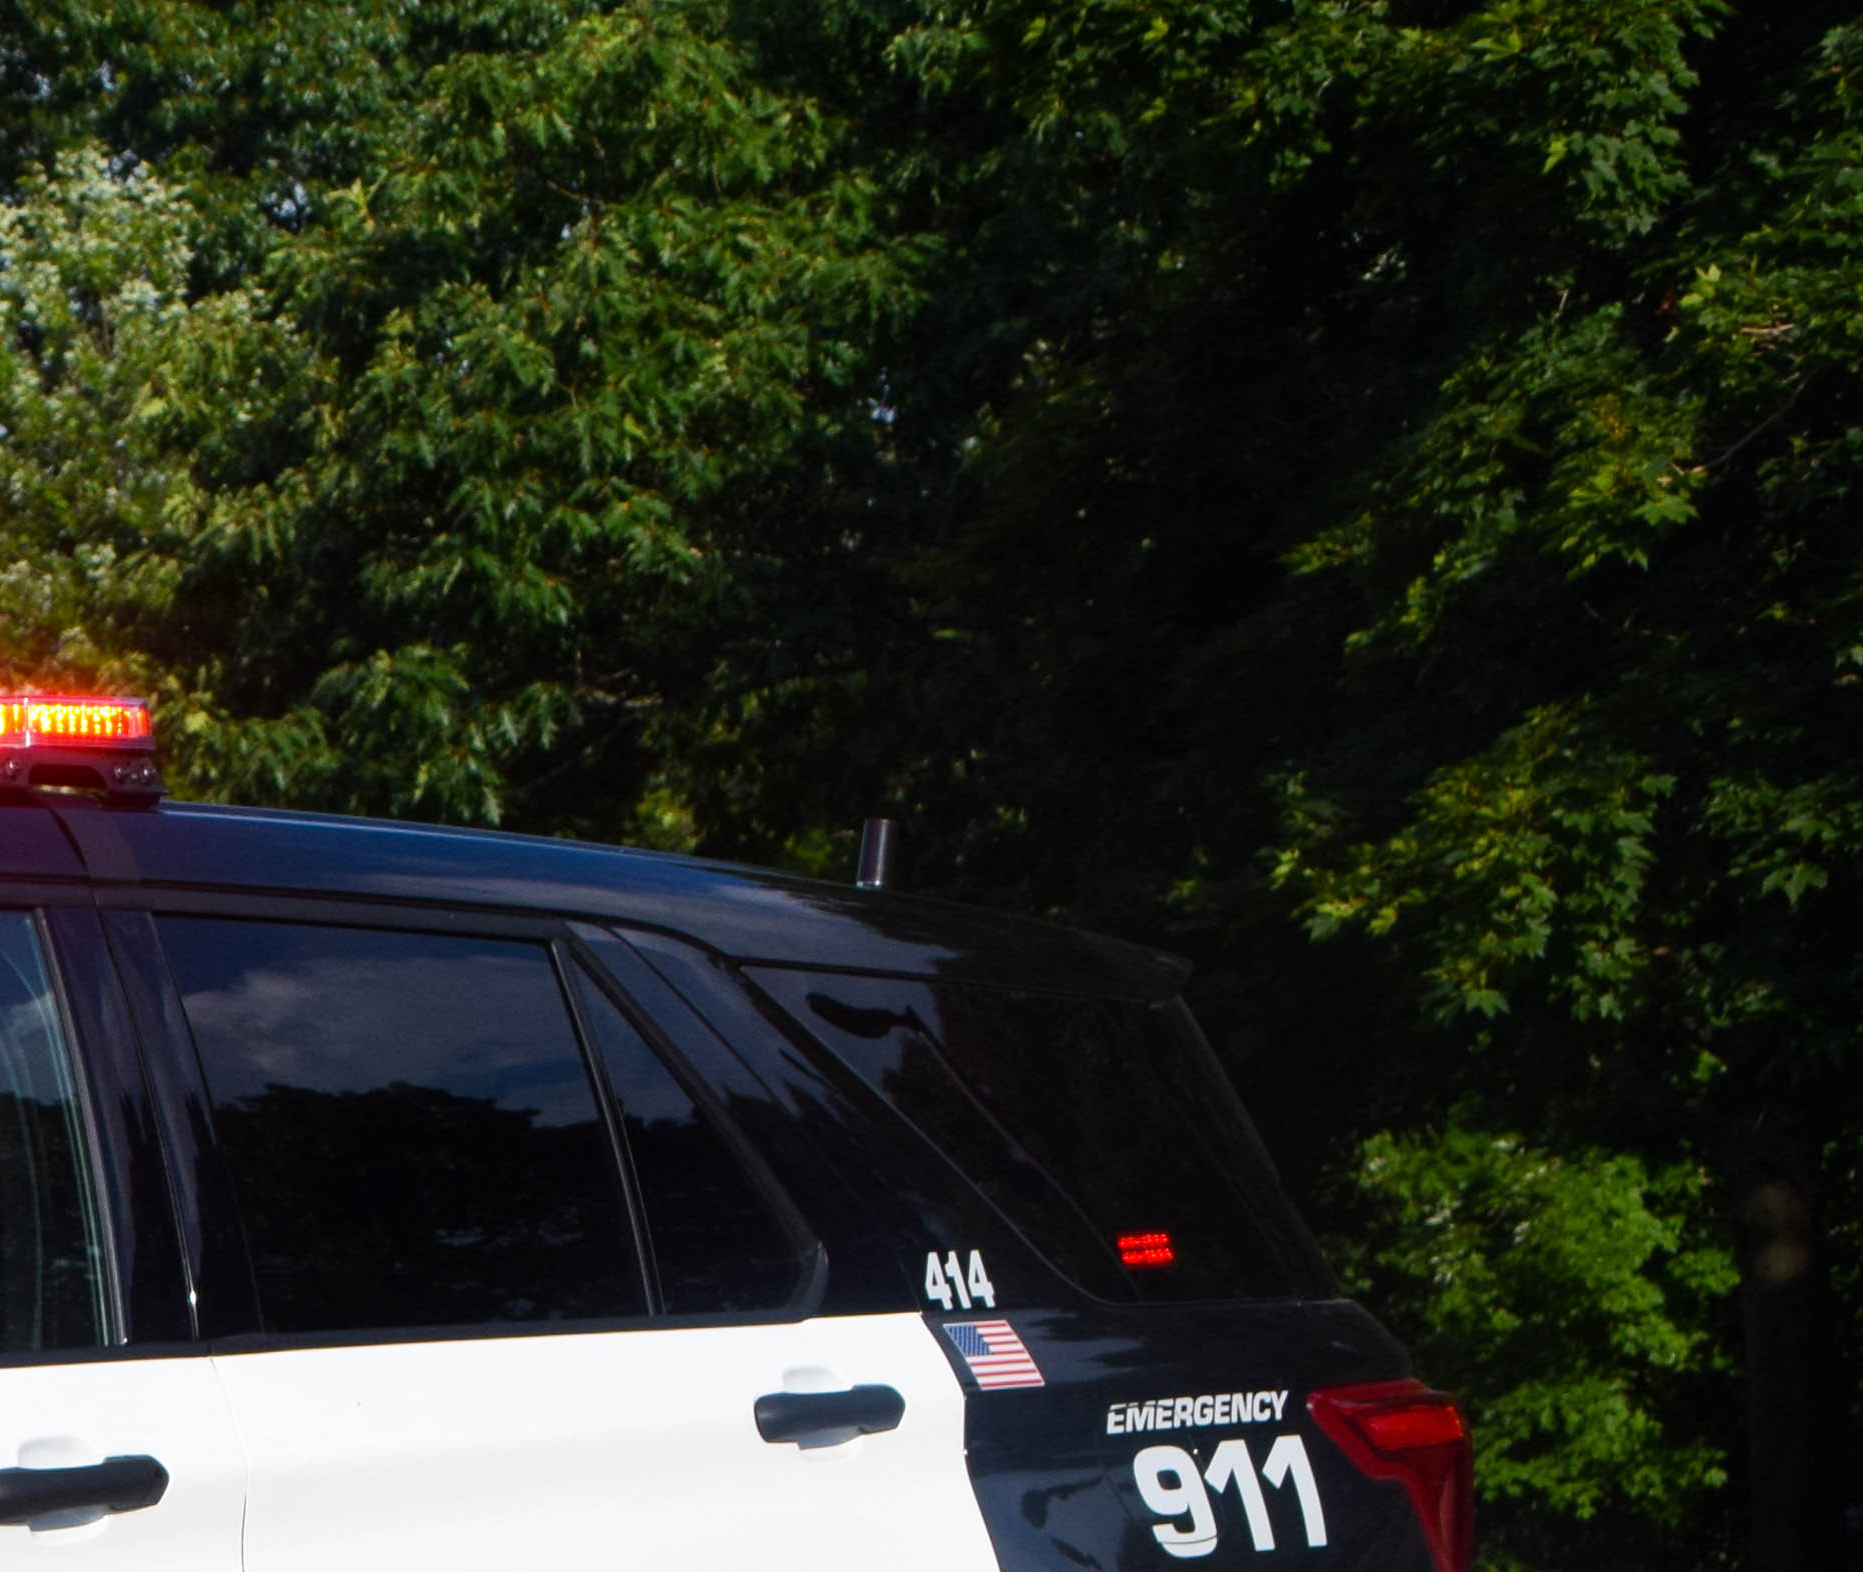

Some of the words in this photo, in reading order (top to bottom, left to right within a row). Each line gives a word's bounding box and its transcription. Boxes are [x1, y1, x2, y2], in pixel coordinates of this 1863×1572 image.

[924, 1249, 995, 1309] 414
[1106, 1390, 1289, 1435] EMERGENCY
[1133, 1434, 1327, 1559] 911
